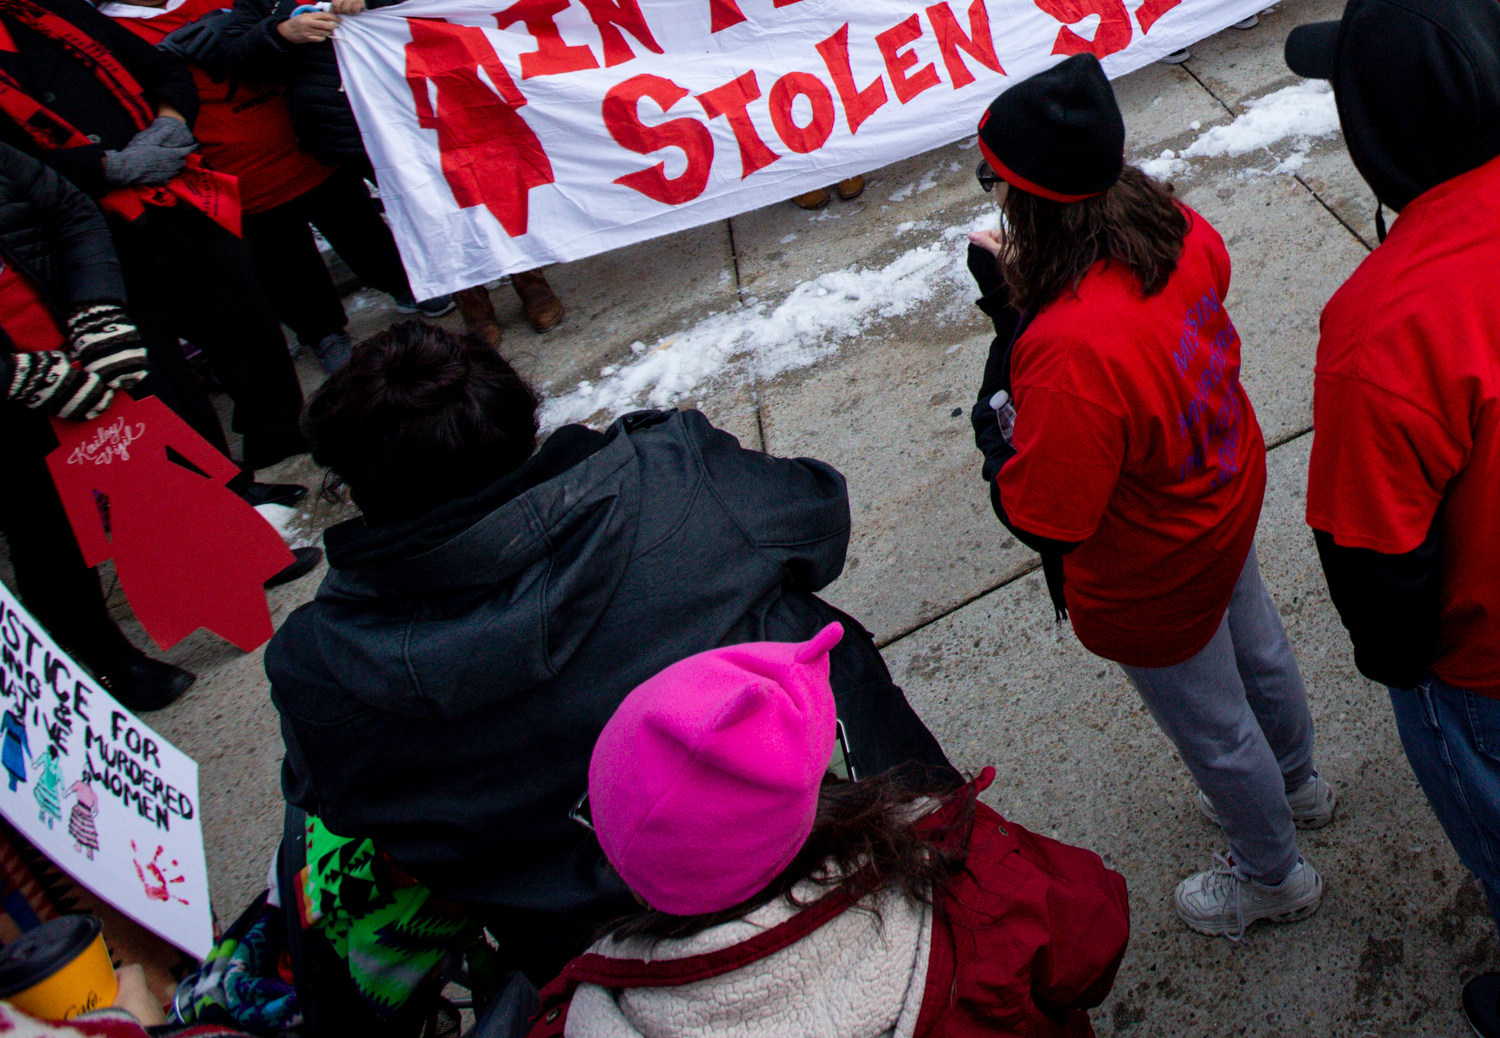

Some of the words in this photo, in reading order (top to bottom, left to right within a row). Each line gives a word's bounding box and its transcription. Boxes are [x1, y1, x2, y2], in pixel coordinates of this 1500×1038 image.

[85, 725, 193, 820] MURDERED
[111, 711, 161, 768] FOR
[86, 750, 170, 832] WOMEN
